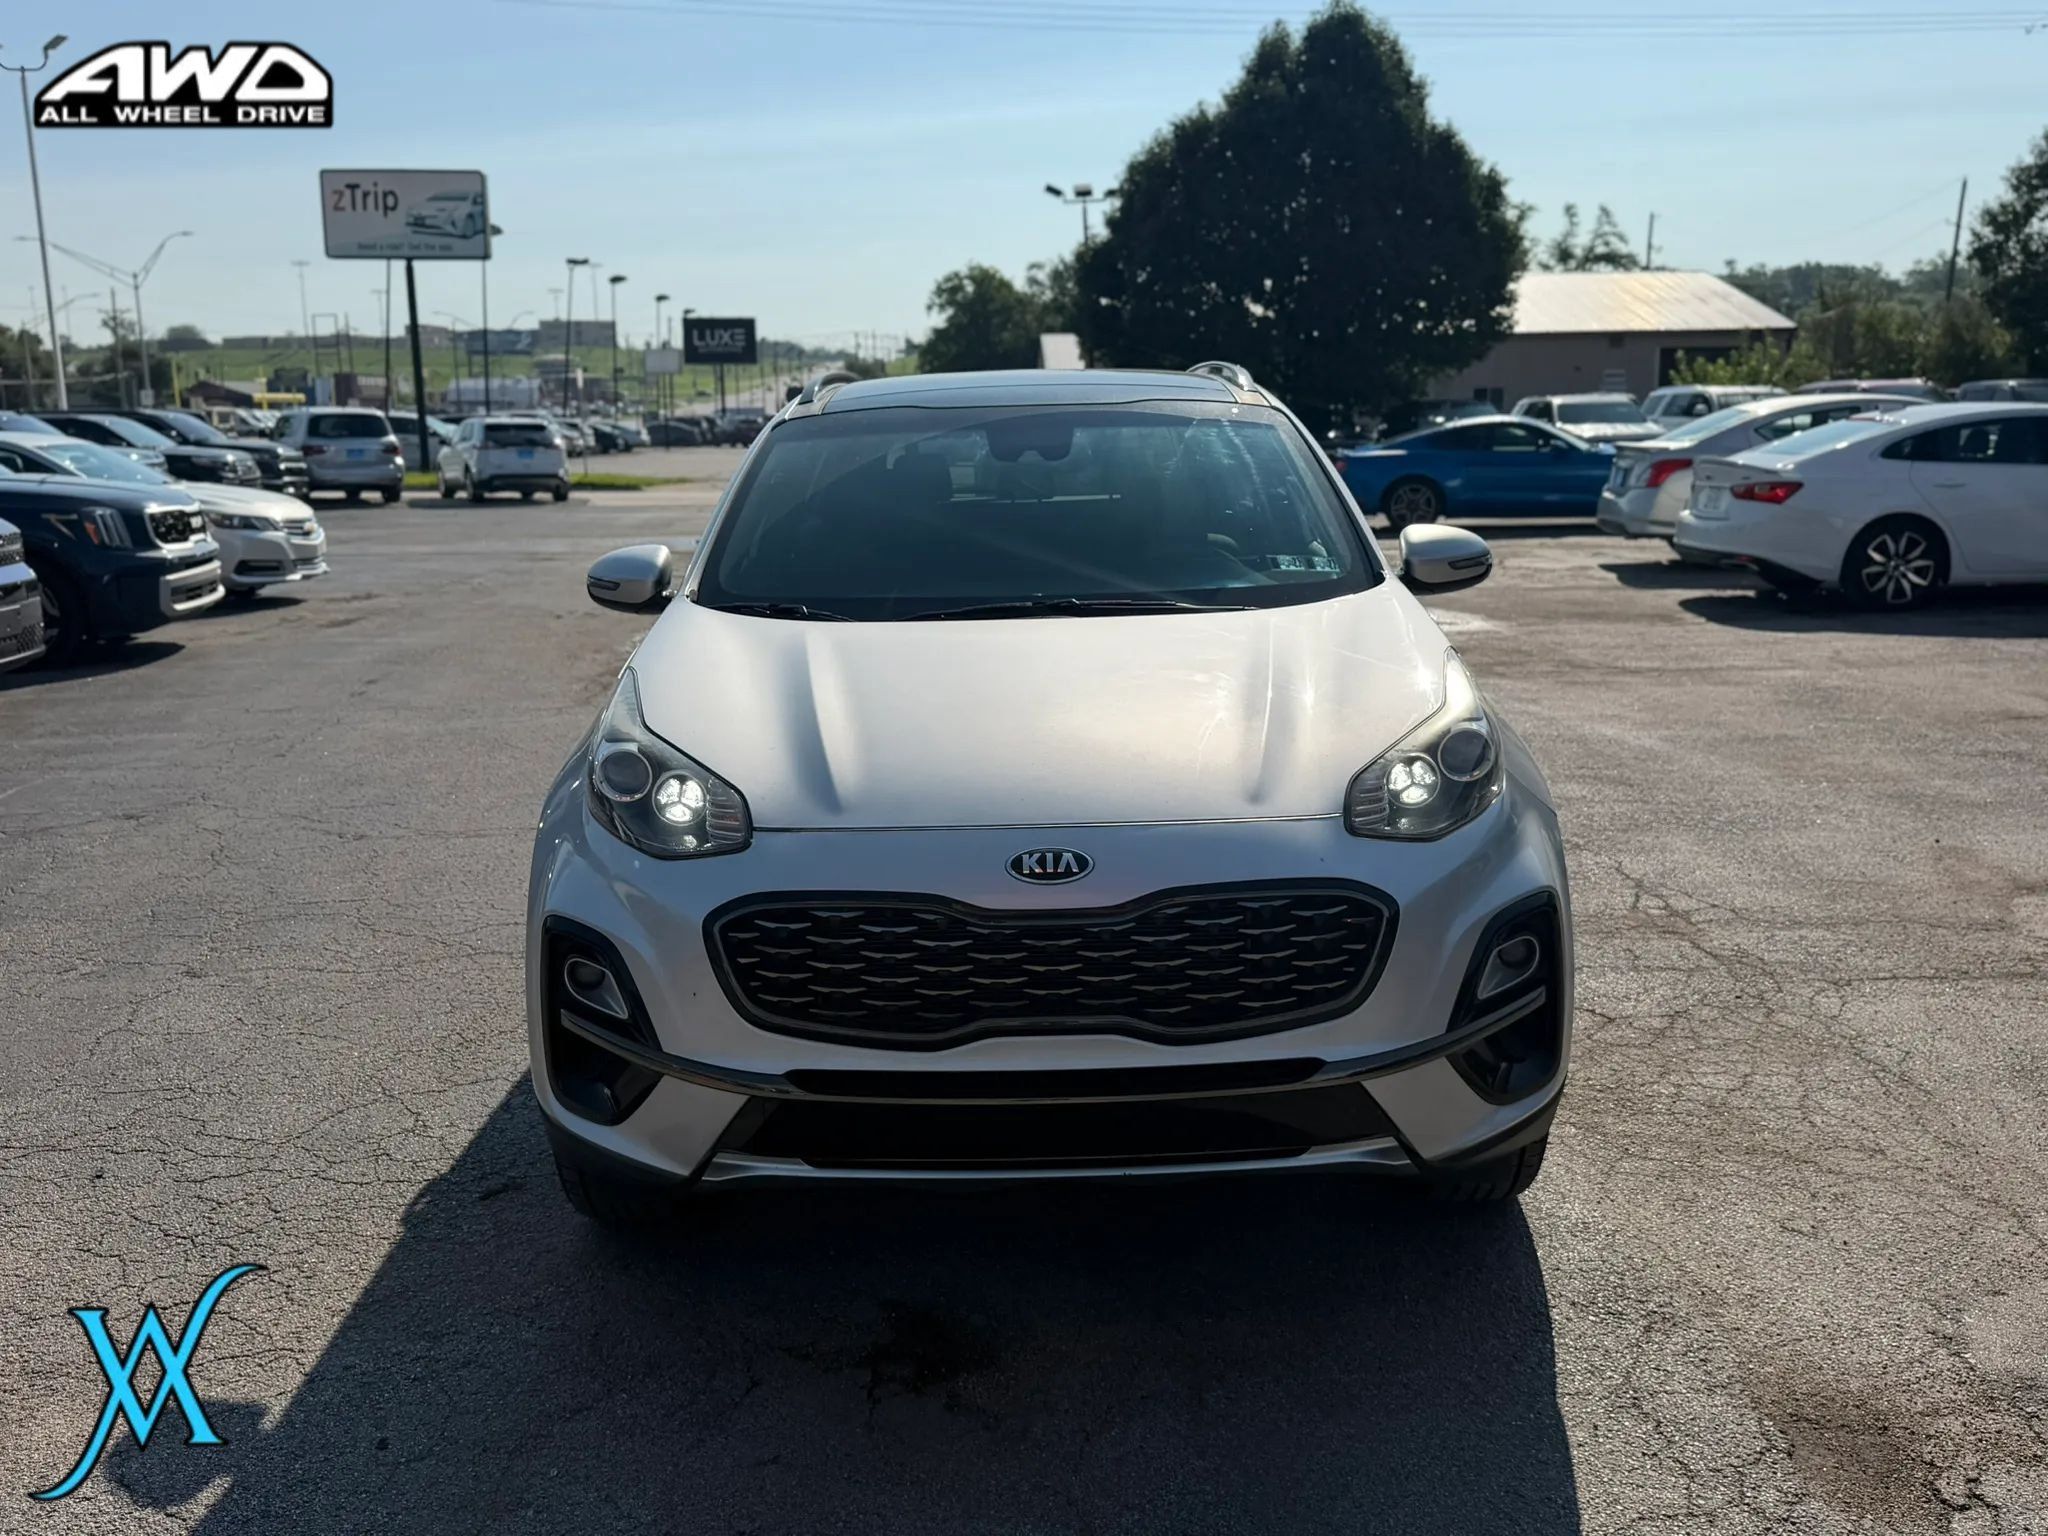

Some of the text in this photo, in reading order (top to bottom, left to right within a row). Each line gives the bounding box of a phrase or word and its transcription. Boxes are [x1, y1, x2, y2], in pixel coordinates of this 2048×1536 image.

[332, 182, 399, 218] zTrip
[693, 328, 747, 347] LUXE
[1021, 851, 1080, 874] KIA
